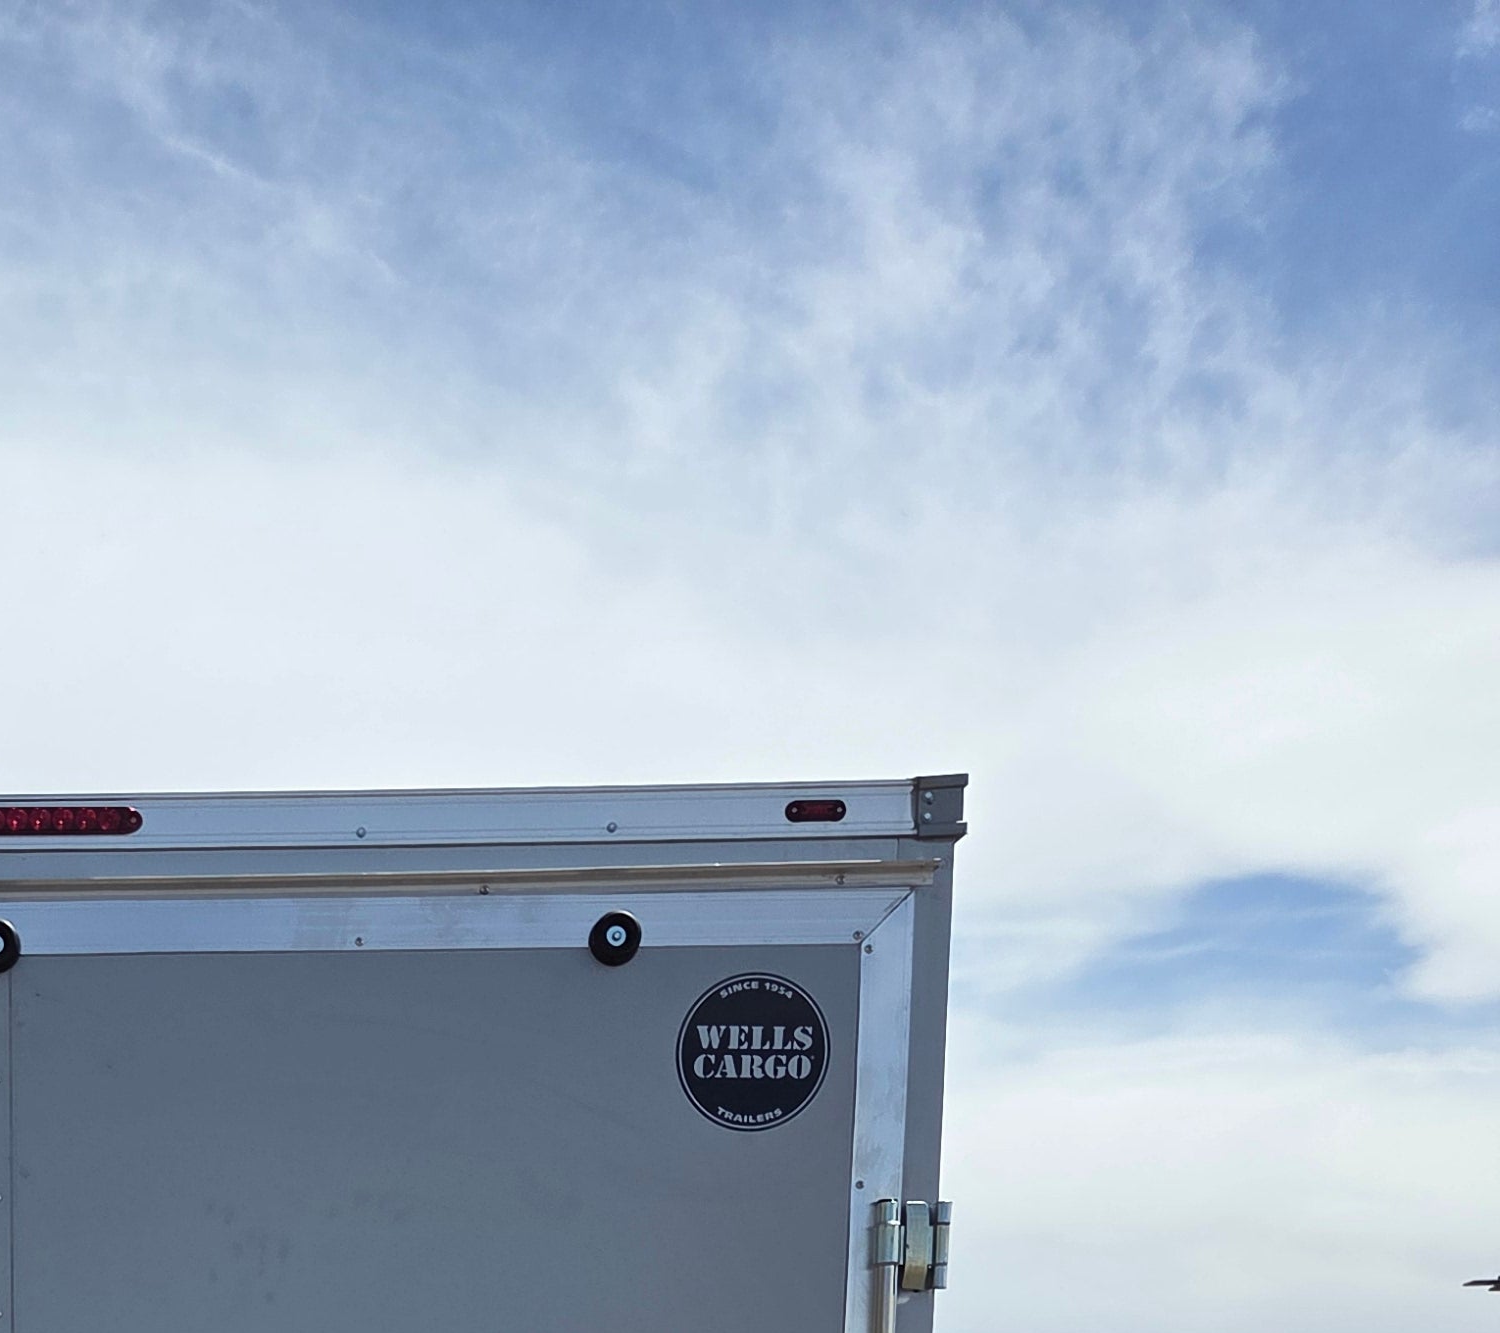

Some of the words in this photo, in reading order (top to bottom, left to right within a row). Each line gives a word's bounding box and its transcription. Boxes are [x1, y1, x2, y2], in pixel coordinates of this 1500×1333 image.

[719, 981, 759, 999] SINCE
[764, 981, 793, 999] 1954
[696, 1025, 813, 1050] WELLS
[693, 1054, 812, 1079] CARGO
[716, 1106, 783, 1123] TRAILERS
